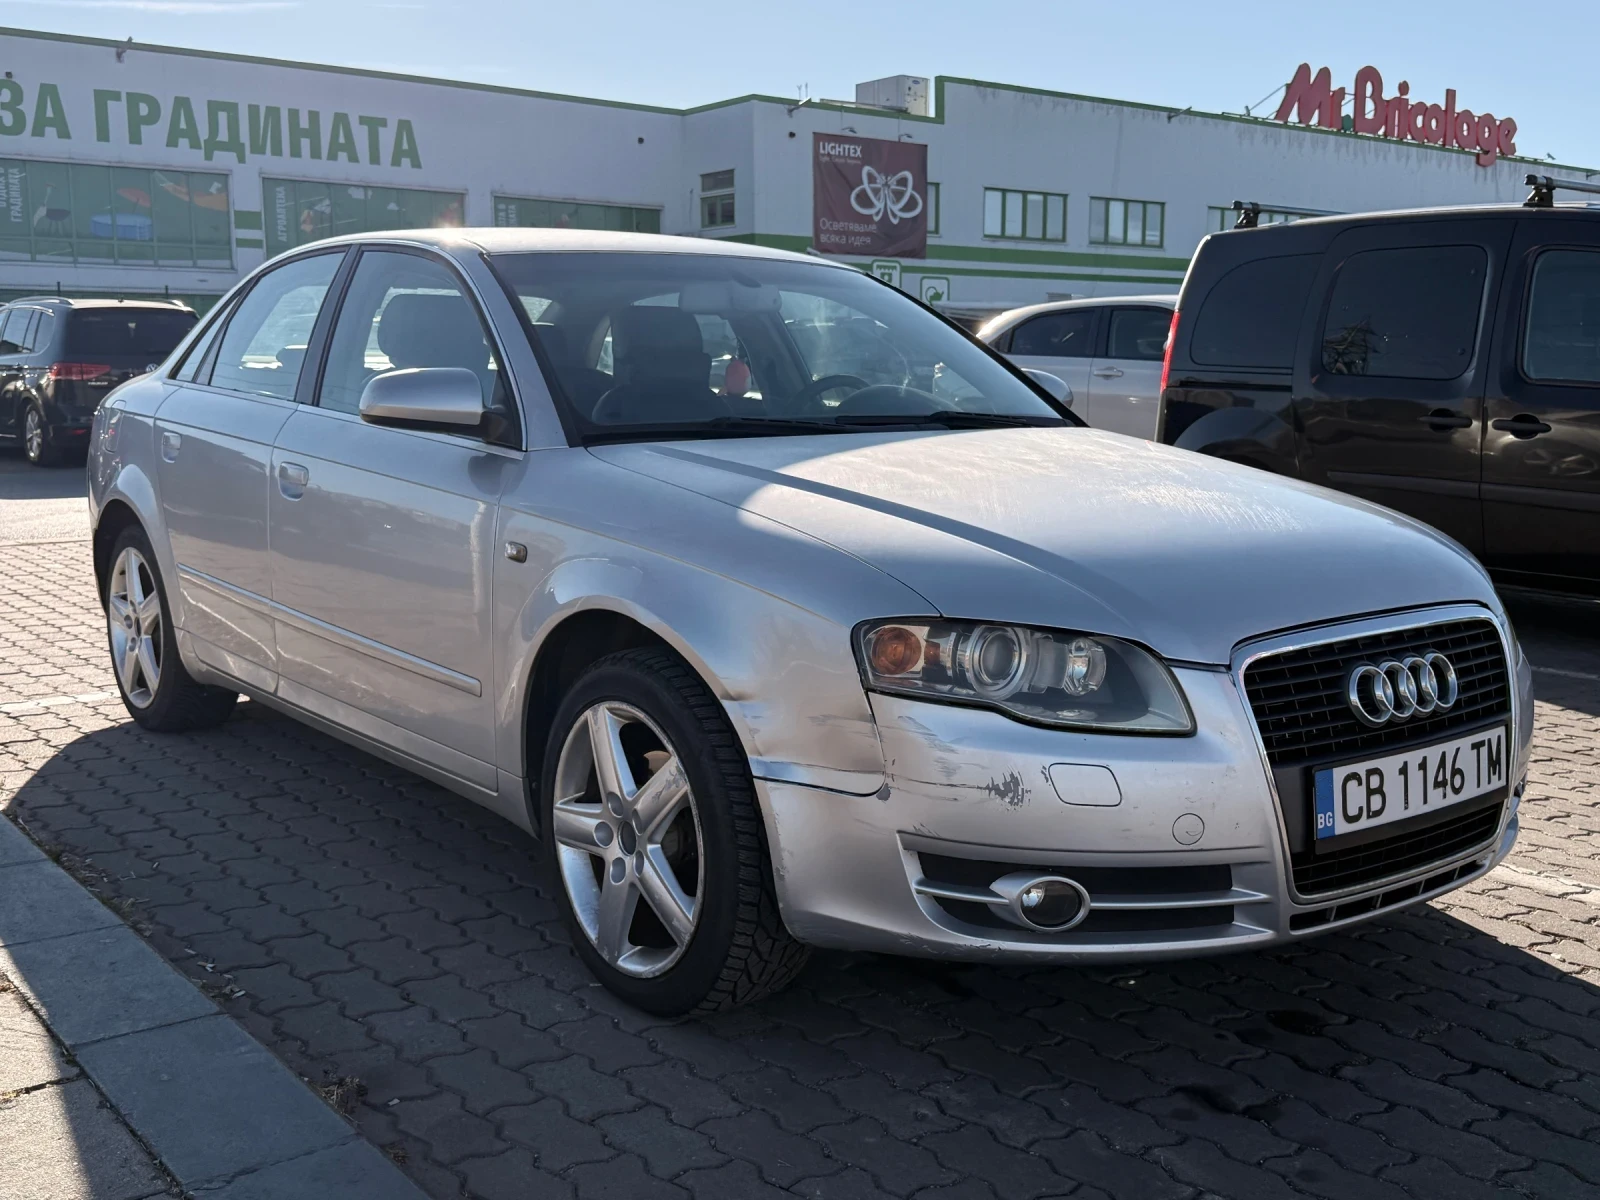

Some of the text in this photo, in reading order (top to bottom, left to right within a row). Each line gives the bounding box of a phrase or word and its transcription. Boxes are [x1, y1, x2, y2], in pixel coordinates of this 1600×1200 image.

[0, 79, 422, 170] ЗА ГРАДИНАТА
[1354, 65, 1518, 167] Bricolage
[819, 141, 862, 158] LIGHTEX
[8, 167, 23, 222] ГРАДИНАТА
[275, 186, 287, 242] АГРОАПТЕКА
[819, 217, 877, 233] Осветяваме
[820, 233, 871, 247] всяка идея
[1341, 735, 1502, 824] CB 1146 TM
[1317, 812, 1333, 829] BG
